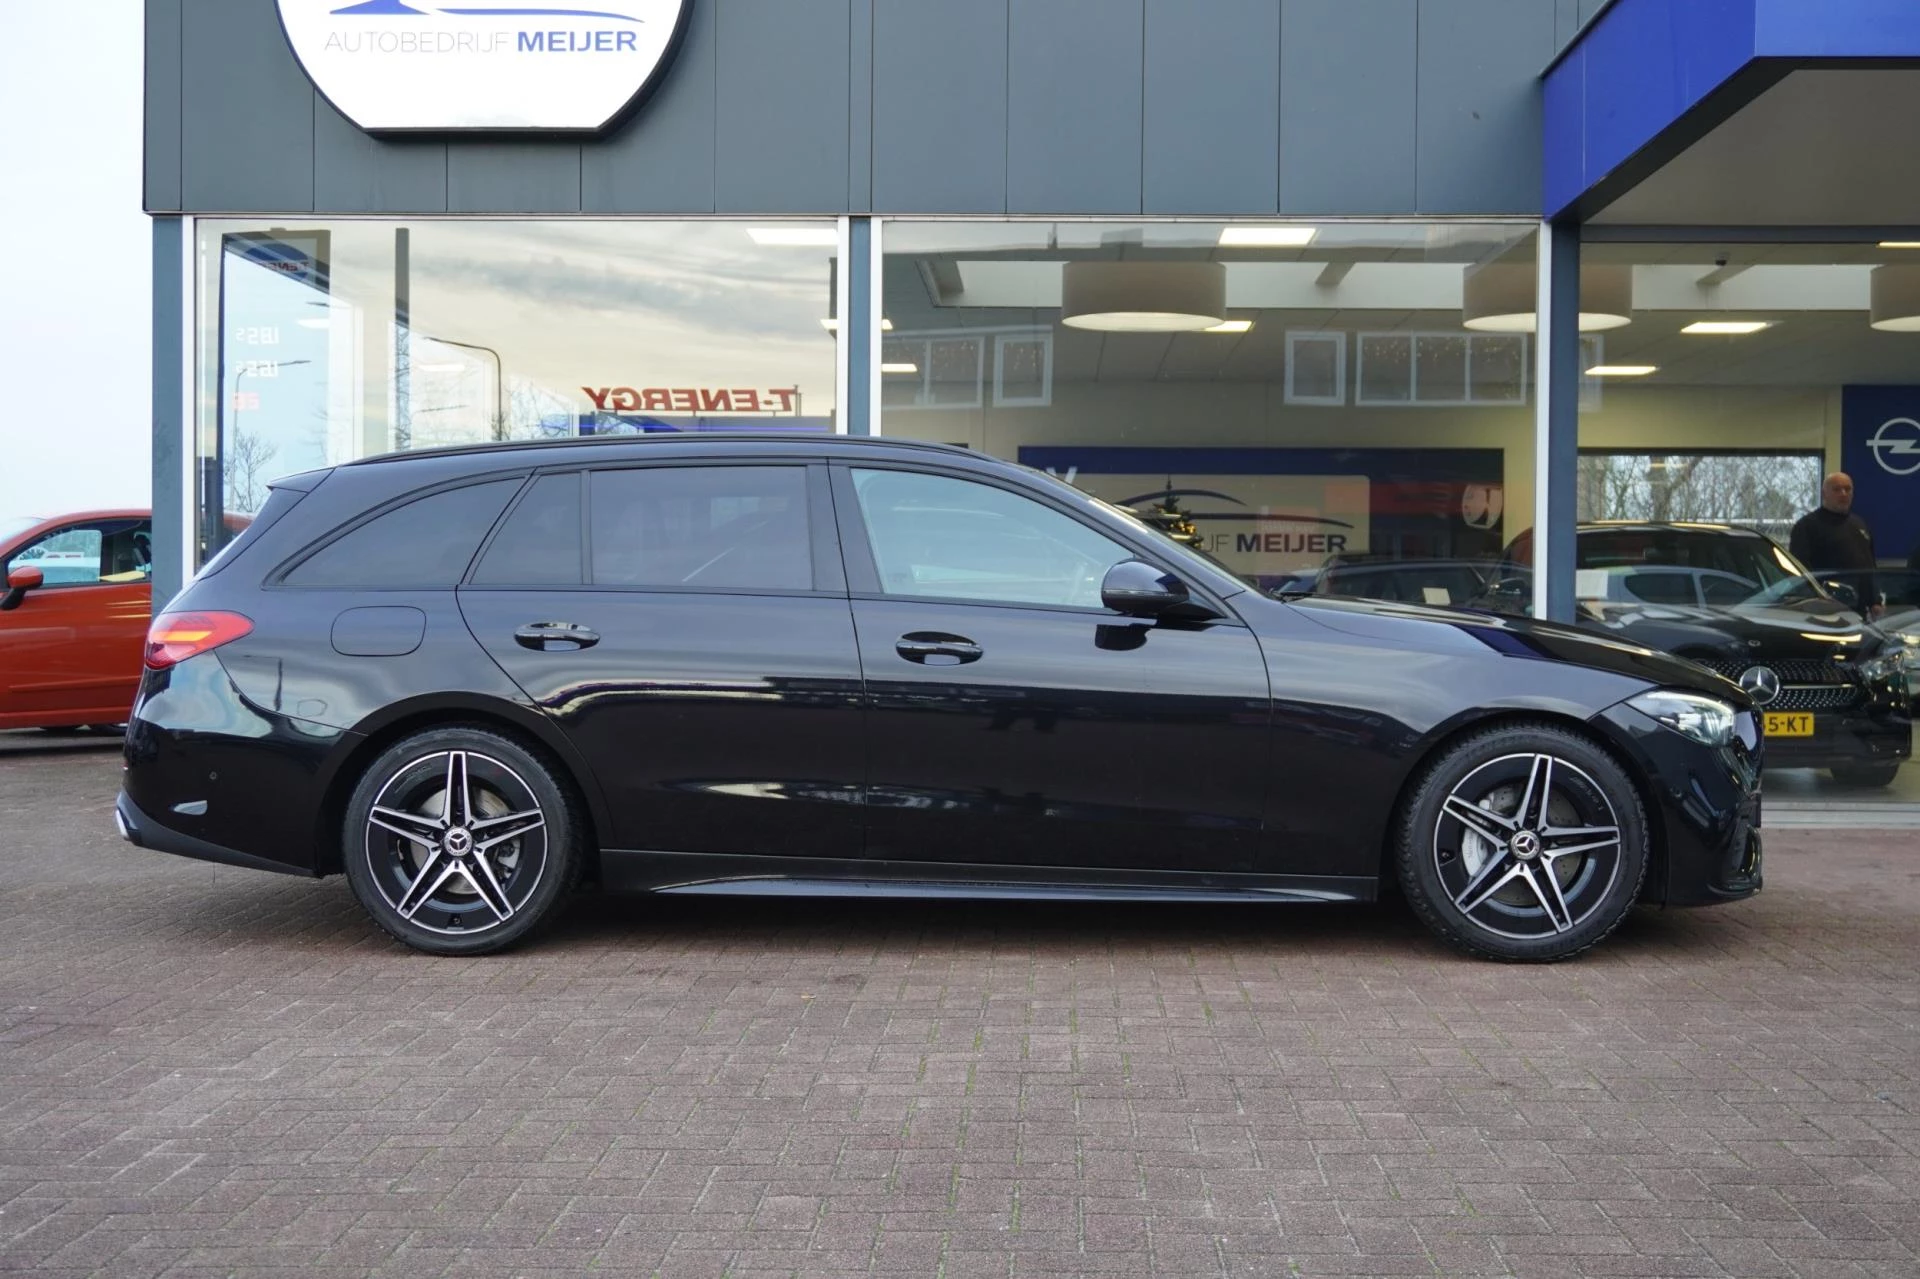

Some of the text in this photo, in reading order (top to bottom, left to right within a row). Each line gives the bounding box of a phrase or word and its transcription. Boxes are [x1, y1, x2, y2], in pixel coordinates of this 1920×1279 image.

[324, 30, 637, 53] AUTOBEDRIJF MEIJER
[1236, 533, 1347, 553] MEIJER
